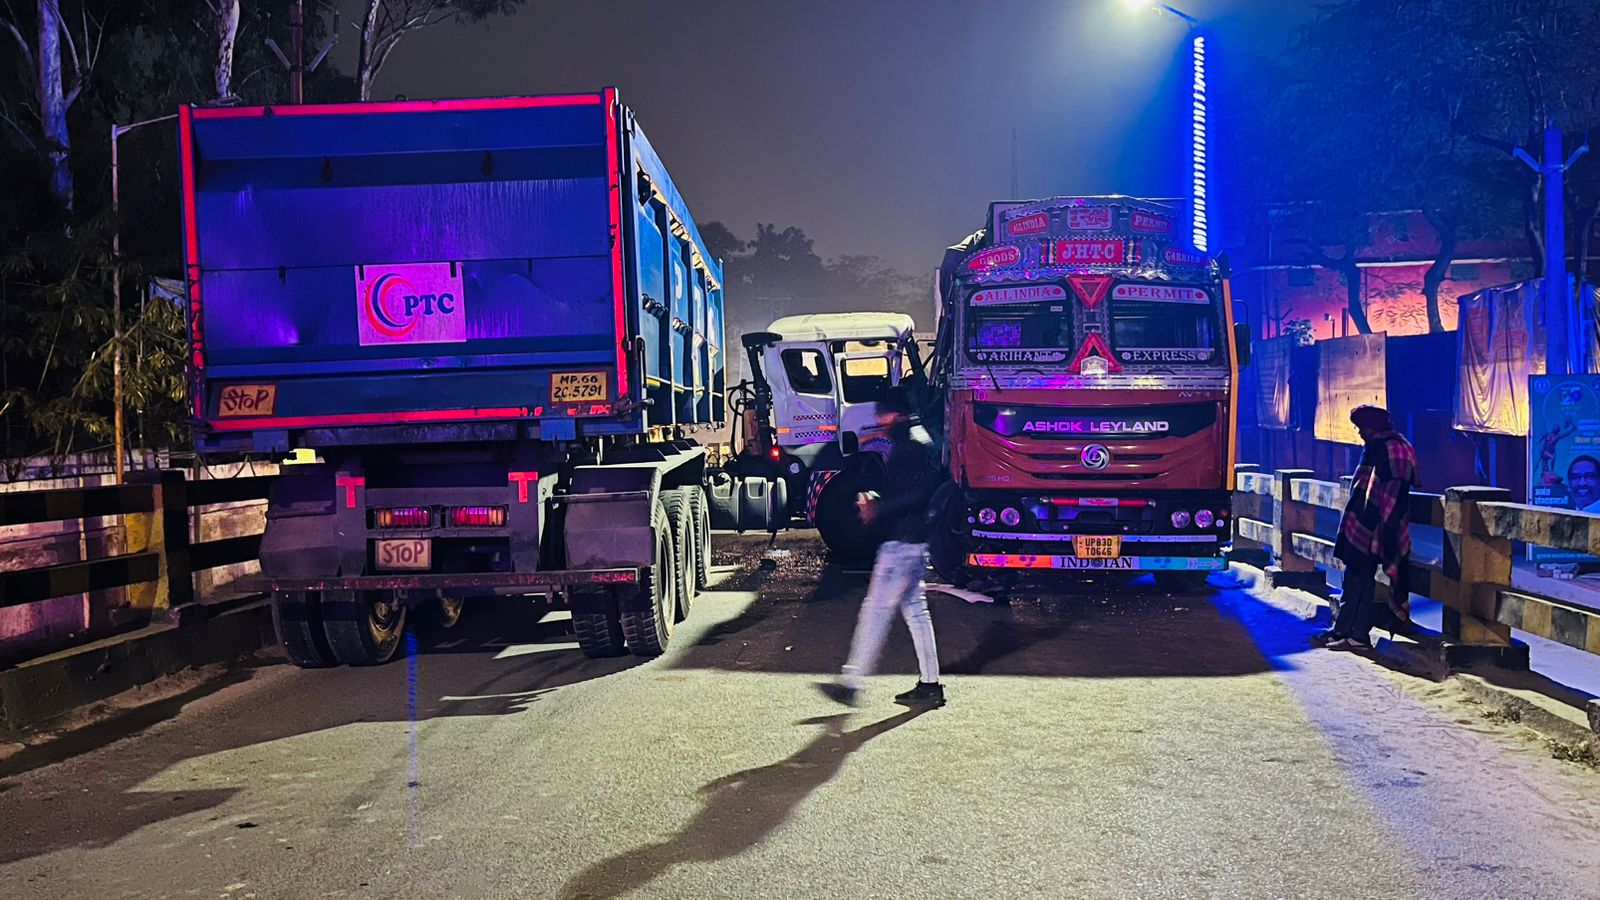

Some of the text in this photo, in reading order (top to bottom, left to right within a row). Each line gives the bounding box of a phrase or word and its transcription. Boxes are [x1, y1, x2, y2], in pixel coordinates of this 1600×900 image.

[1024, 217, 1046, 231] INDIA
[1134, 214, 1168, 230] PERMIT
[979, 250, 1015, 265] GOODS
[1165, 250, 1200, 263] CARRIER
[985, 287, 1051, 302] ALL INDIA
[1127, 287, 1194, 299] PERMIT
[402, 293, 455, 316] PTC
[989, 351, 1052, 362] ARIHANT
[1133, 351, 1196, 361] EXPRESS
[1022, 421, 1169, 432] ASHOK LEYLAND
